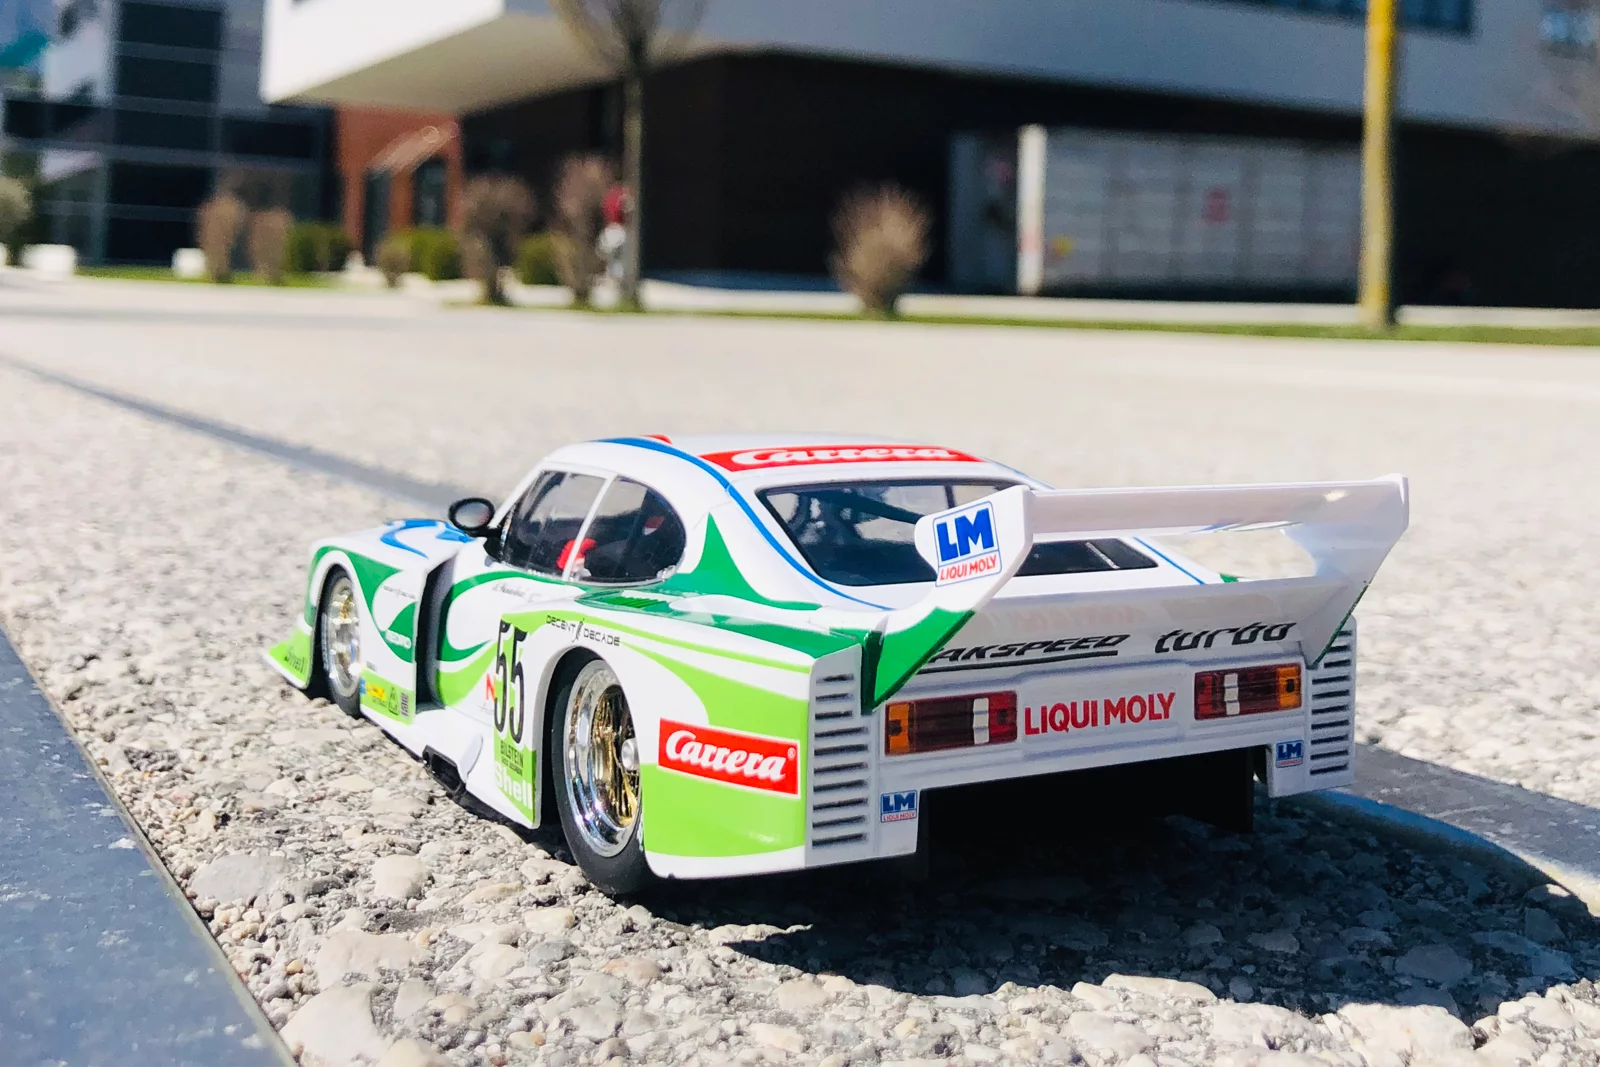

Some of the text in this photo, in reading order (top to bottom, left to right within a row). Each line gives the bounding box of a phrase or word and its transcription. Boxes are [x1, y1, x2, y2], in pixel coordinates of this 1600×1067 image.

[731, 447, 956, 465] Carrera
[936, 508, 994, 562] LM
[940, 554, 997, 581] LIQUI MOLY
[546, 614, 621, 647] DECENT DECADE
[928, 621, 1297, 664] AKSPEED turbo
[494, 619, 528, 744] 55
[1024, 692, 1176, 735] LIQUI MOLY
[1278, 742, 1302, 760] LM
[494, 760, 533, 810] Shell
[883, 792, 915, 812] LM
